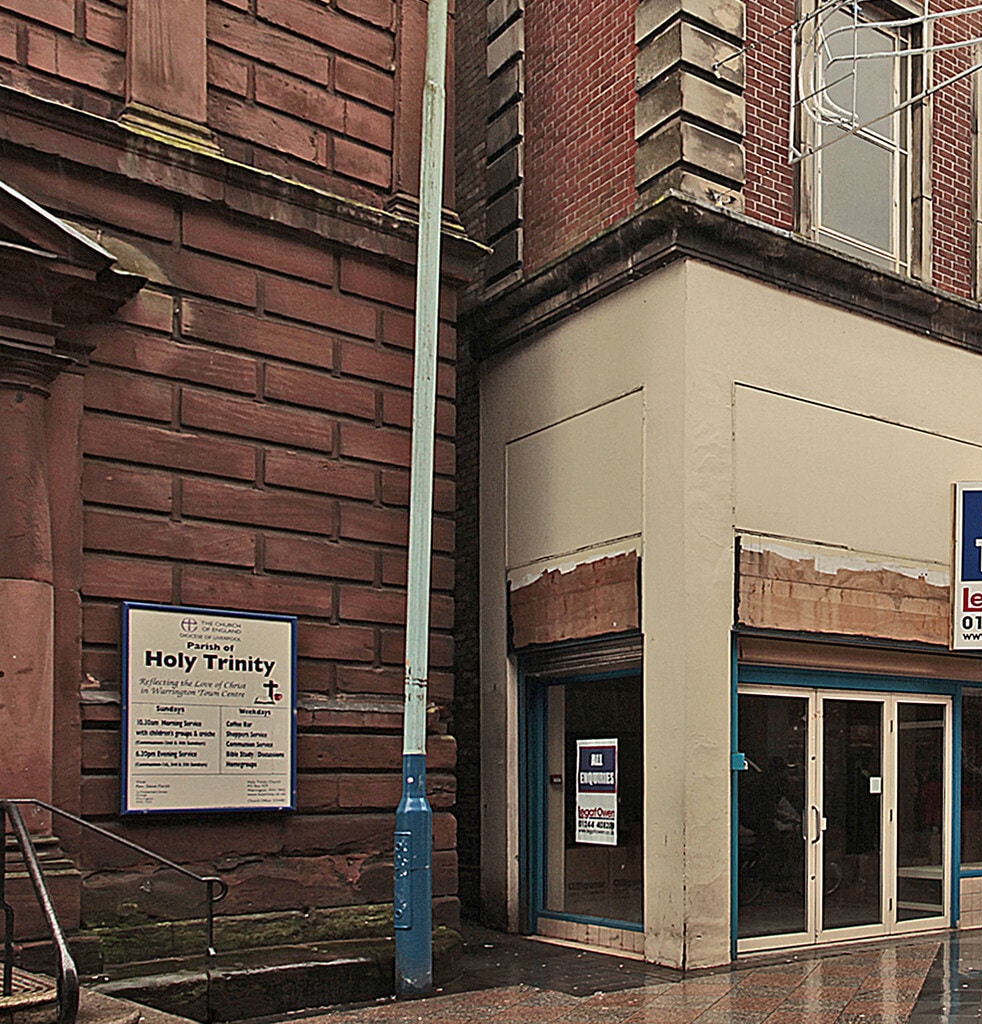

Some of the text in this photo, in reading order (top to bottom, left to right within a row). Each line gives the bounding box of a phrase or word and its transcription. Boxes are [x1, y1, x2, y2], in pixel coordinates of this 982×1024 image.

[187, 642, 234, 652] Parish of
[145, 650, 275, 677] Holy Trinity
[140, 678, 246, 690] Reflecting the Love of Christ
[152, 687, 196, 698] Warrington
[222, 690, 245, 698] Centre
[156, 706, 185, 714] Sundays
[239, 708, 271, 717] Weekdays
[591, 754, 603, 766] ALL
[580, 772, 614, 785] ENQUIRIES
